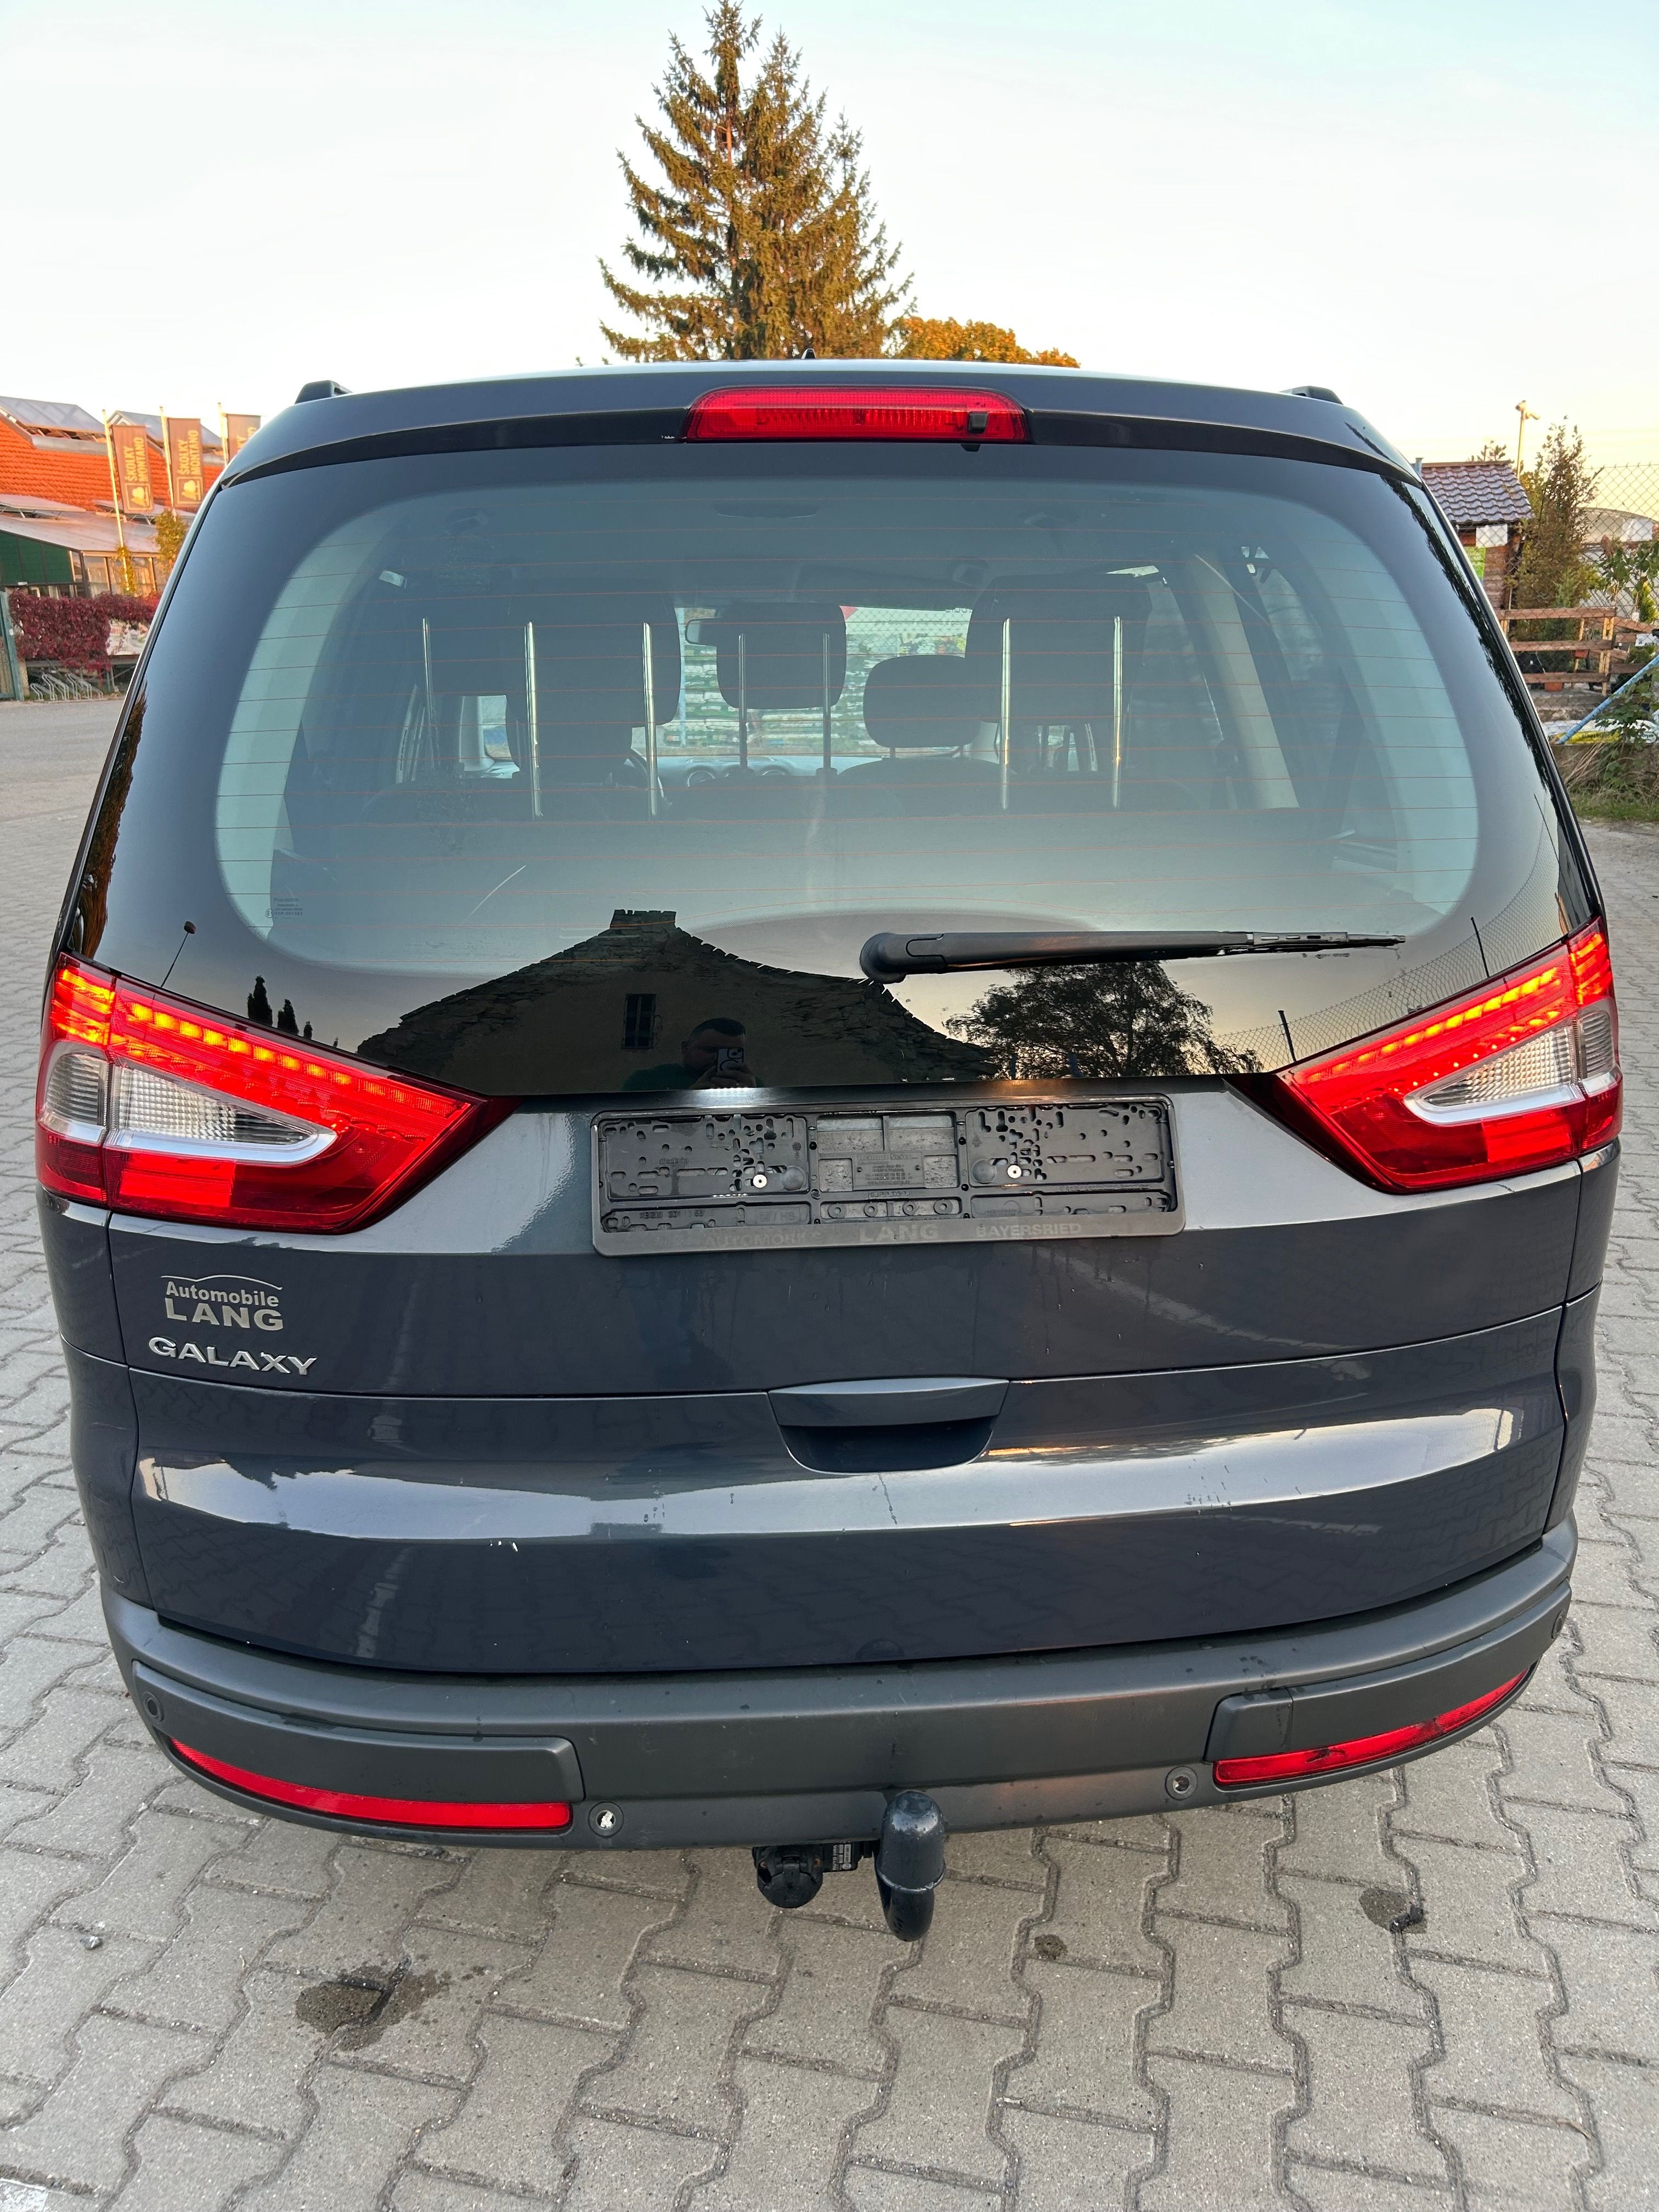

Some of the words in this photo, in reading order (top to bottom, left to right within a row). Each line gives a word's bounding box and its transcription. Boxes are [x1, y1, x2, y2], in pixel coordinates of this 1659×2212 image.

[123, 446, 138, 482] ŠKOLKY
[133, 437, 149, 482] MONTANO
[178, 439, 190, 475] ŠKOLKY
[188, 430, 201, 475] MONTANO
[860, 1223, 939, 1242] LANG
[976, 1223, 1081, 1238] BAYERSRIED
[166, 1281, 279, 1307] Automobile
[165, 1297, 284, 1331] LANG
[149, 1336, 318, 1375] GALAXY
